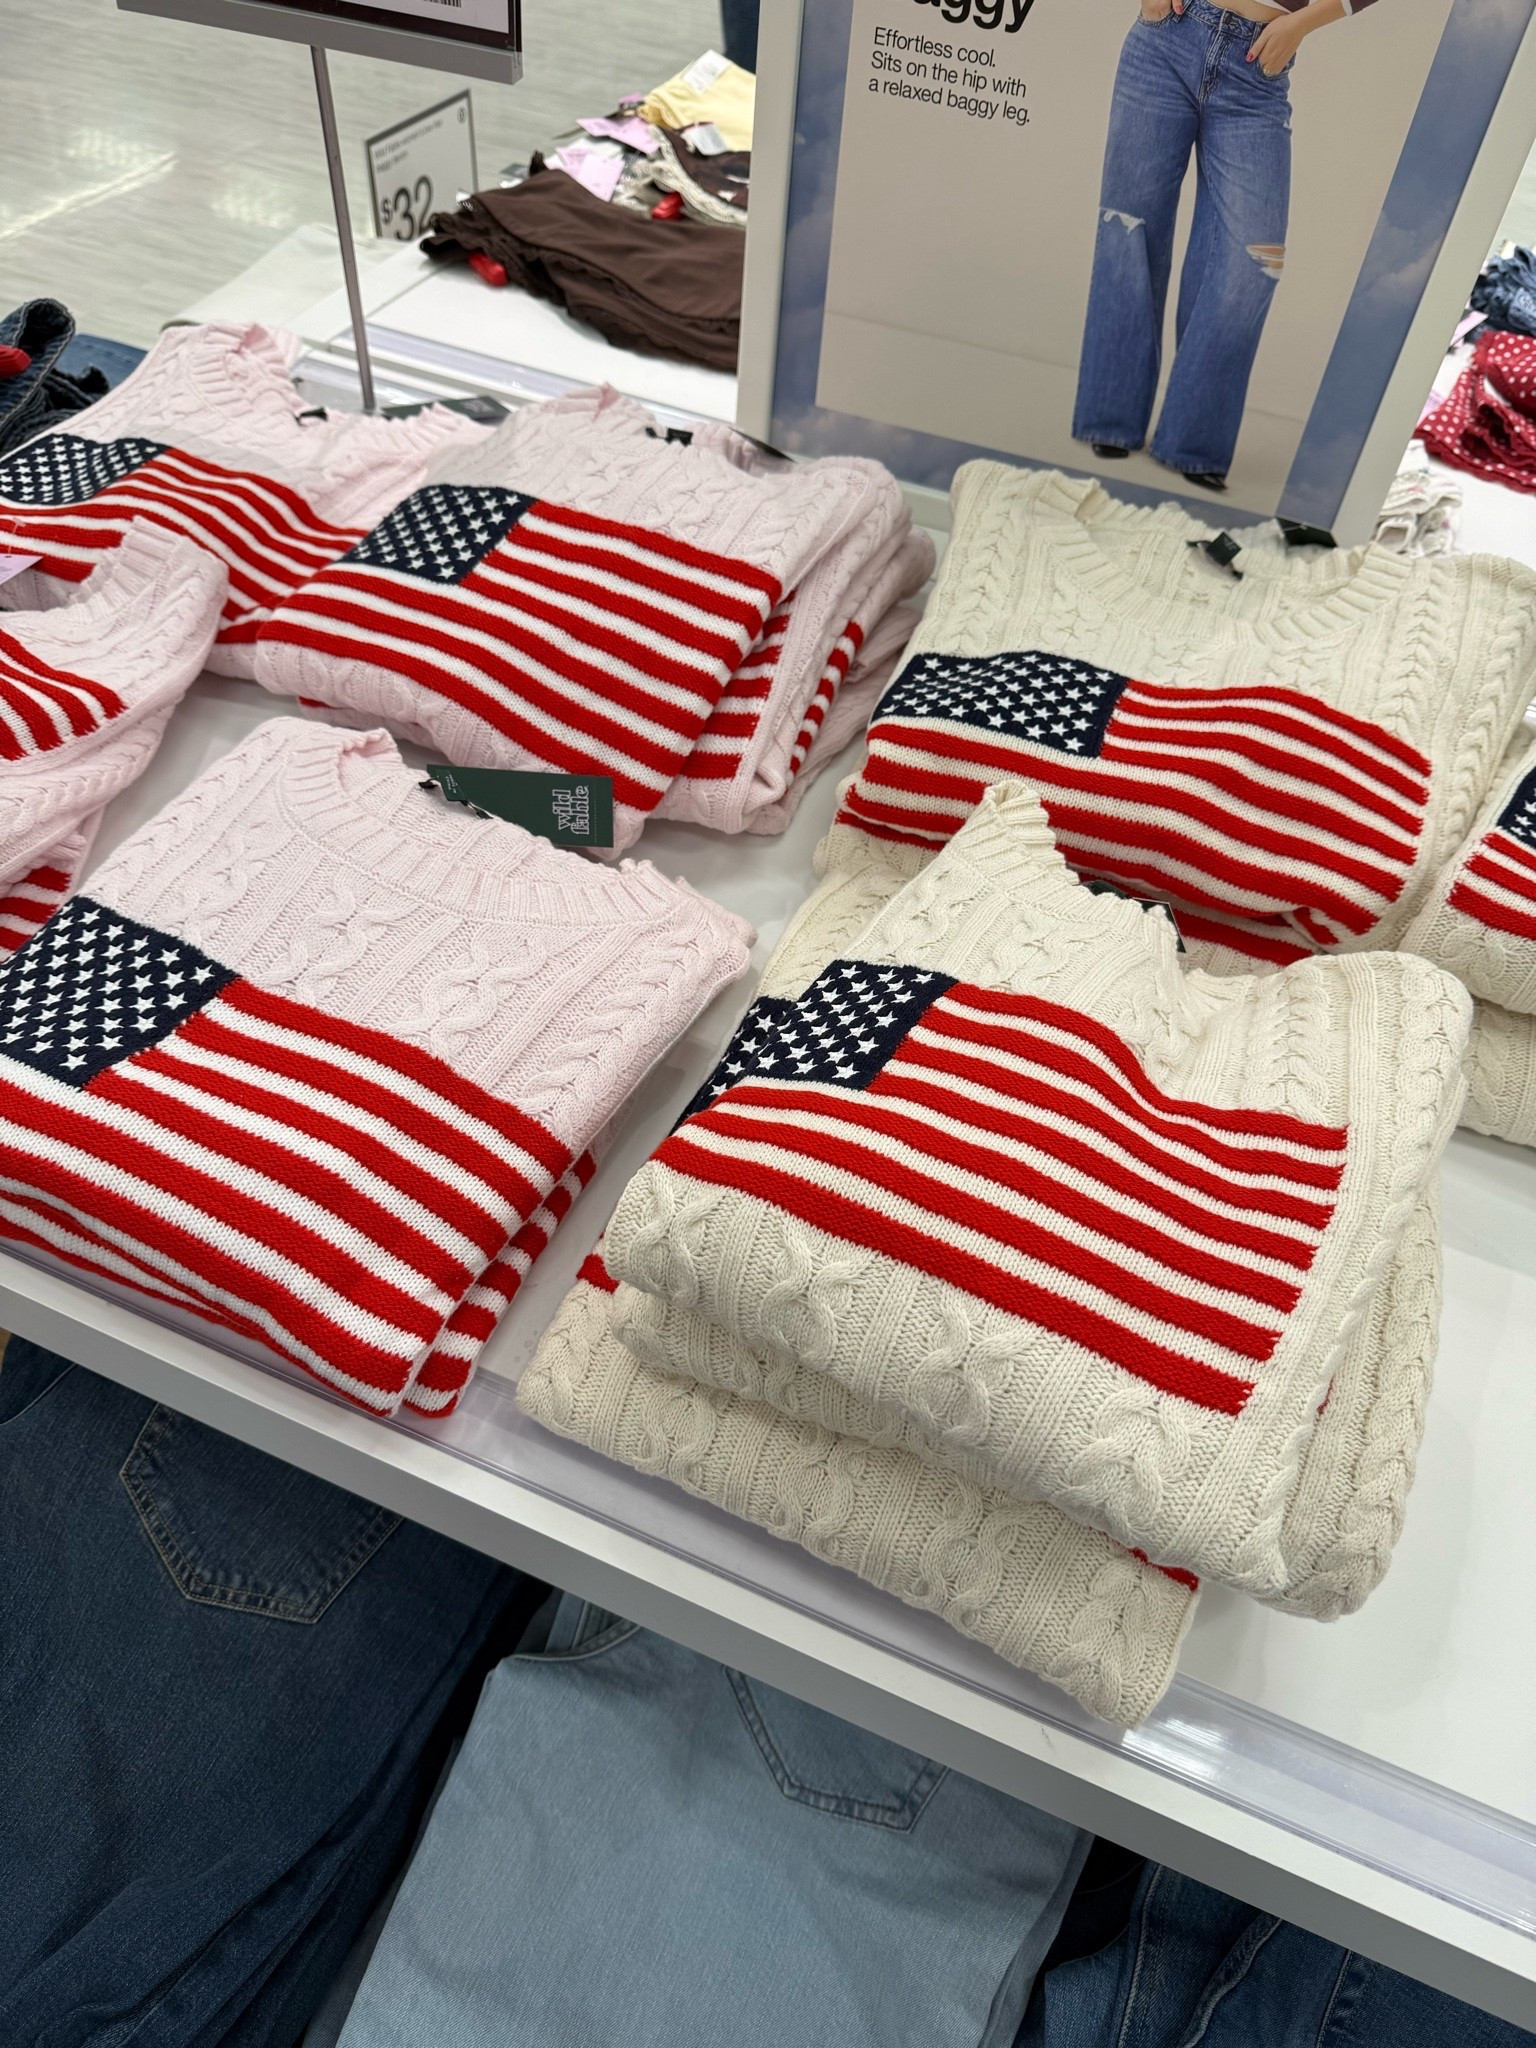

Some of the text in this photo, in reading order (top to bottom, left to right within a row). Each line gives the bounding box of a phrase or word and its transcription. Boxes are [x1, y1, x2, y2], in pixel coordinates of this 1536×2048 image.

[874, 26, 996, 67] Effortless cool.
[871, 51, 1027, 98] Sits on the hip with
[868, 78, 1030, 126] a relaxed baggy leg.
[382, 175, 433, 241] $32
[552, 789, 571, 830] wild
[570, 785, 589, 835] fable
